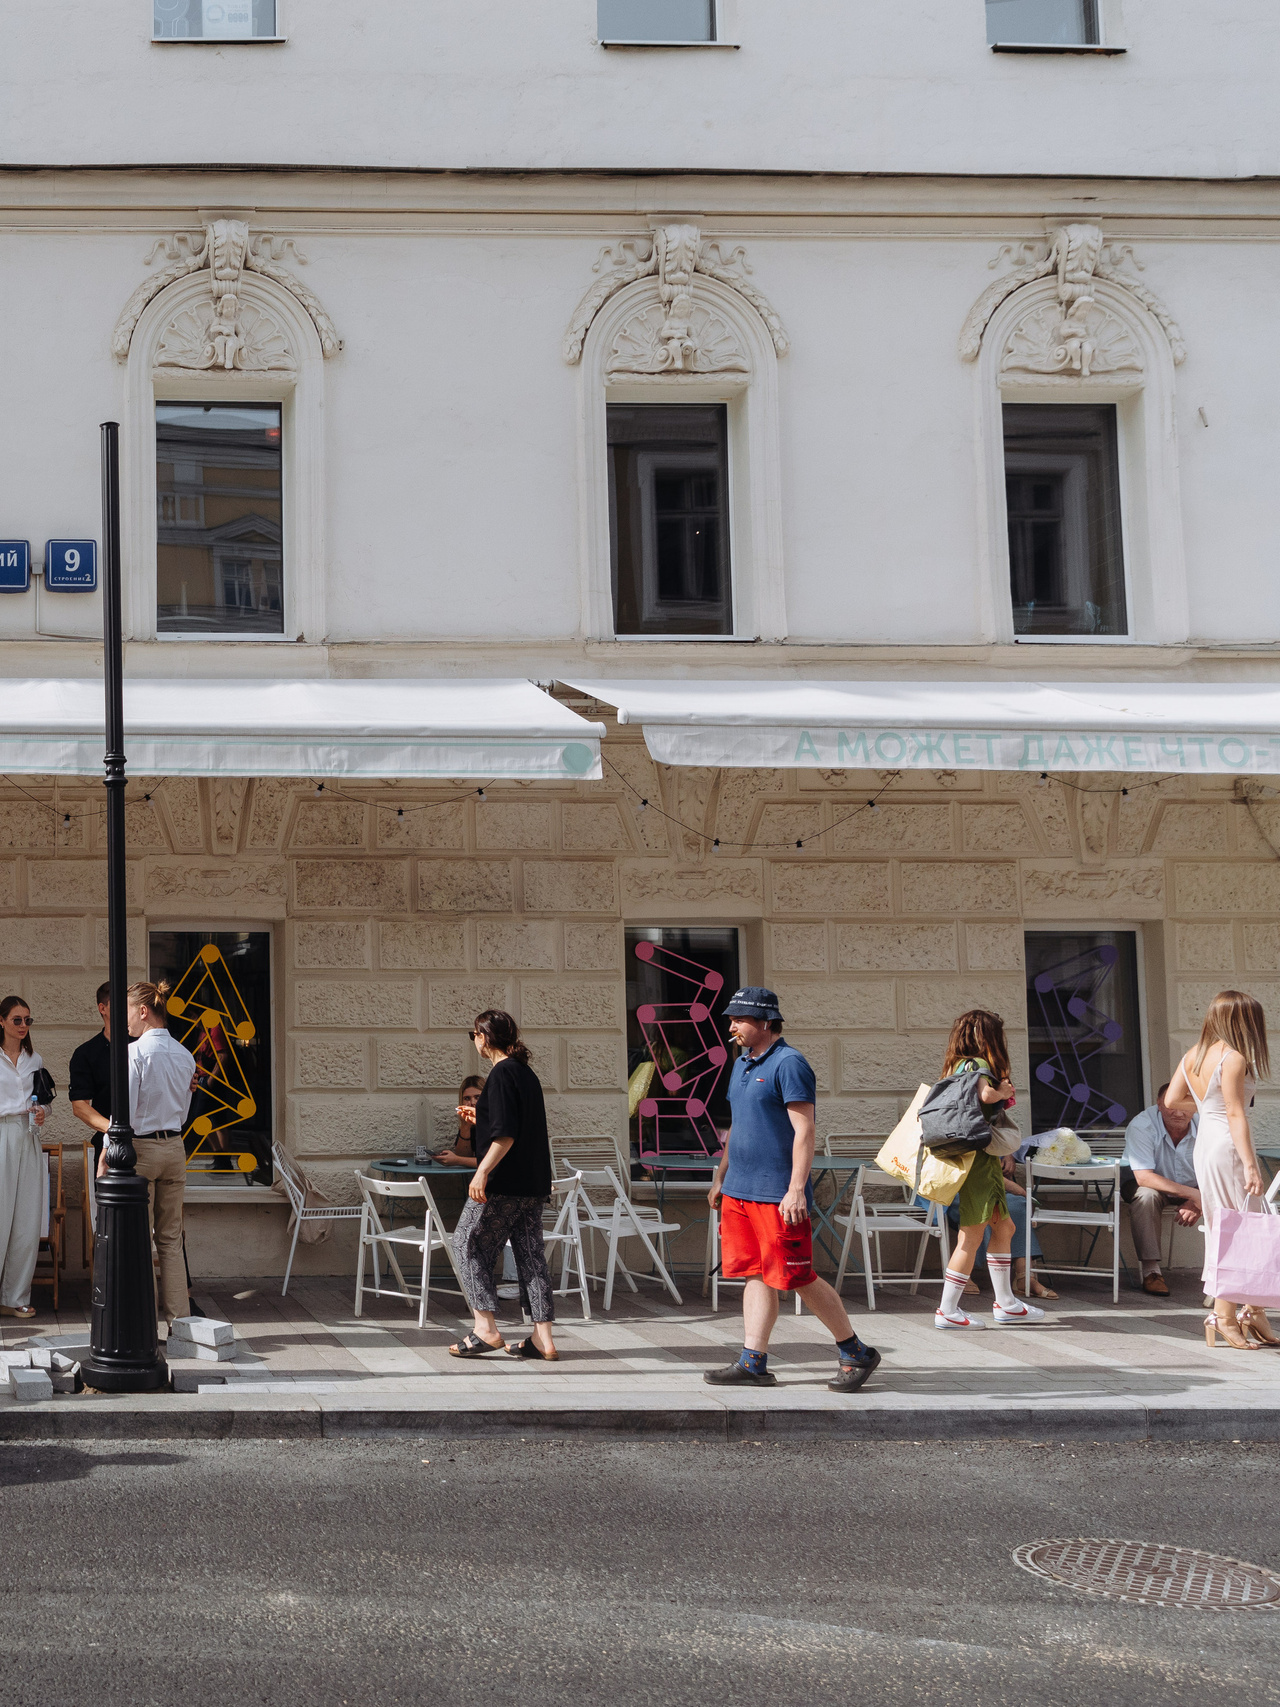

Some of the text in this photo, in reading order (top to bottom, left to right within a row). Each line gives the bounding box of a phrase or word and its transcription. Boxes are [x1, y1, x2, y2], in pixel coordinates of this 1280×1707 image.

[64, 549, 80, 572] 9
[84, 574, 91, 582] 2
[794, 731, 820, 761] А
[836, 731, 1002, 764] МОЖЕТ
[1018, 734, 1147, 770] ДАЖЕ
